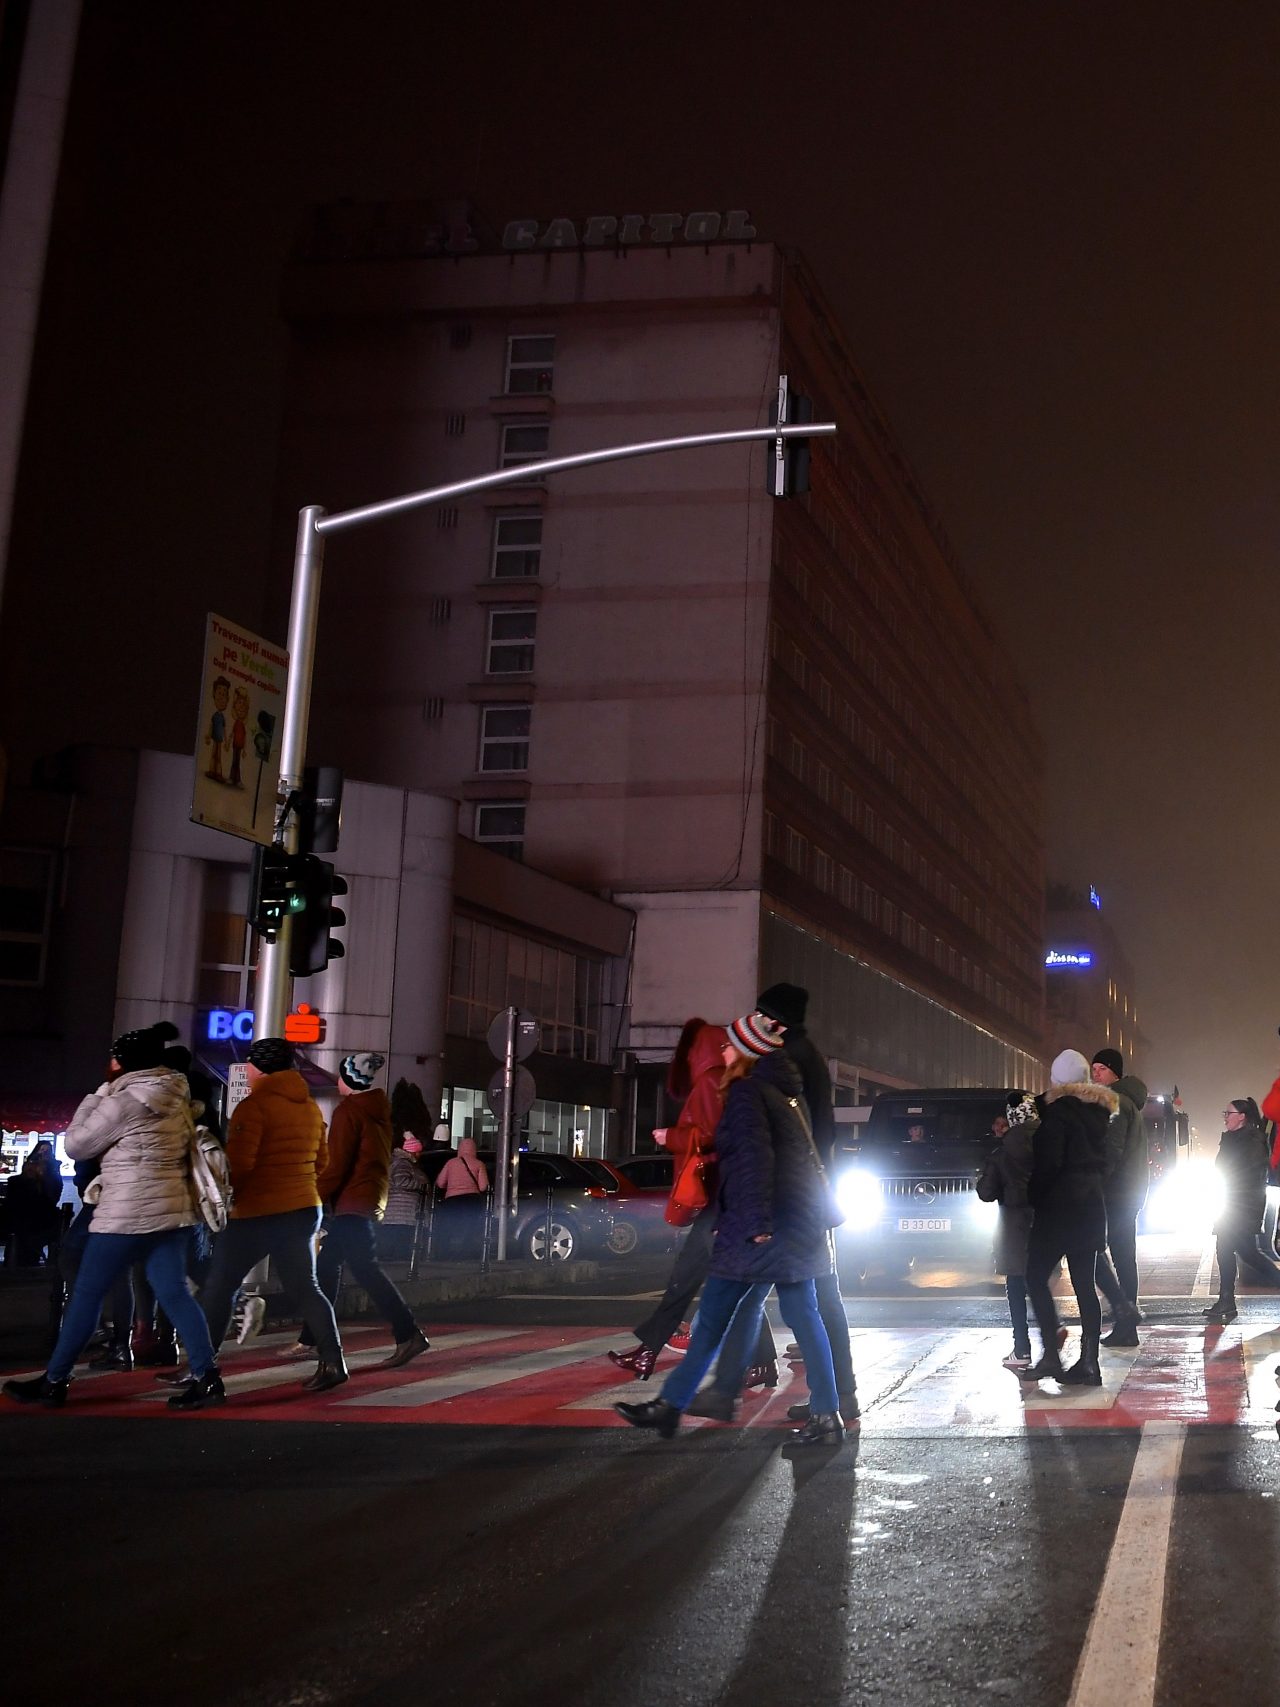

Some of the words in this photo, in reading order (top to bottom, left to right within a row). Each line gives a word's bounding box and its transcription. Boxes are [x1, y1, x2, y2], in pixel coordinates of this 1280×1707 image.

[502, 210, 756, 248] CAPITOL
[224, 646, 238, 662] pe
[241, 651, 274, 679] Verde
[912, 1220, 924, 1230] 33
